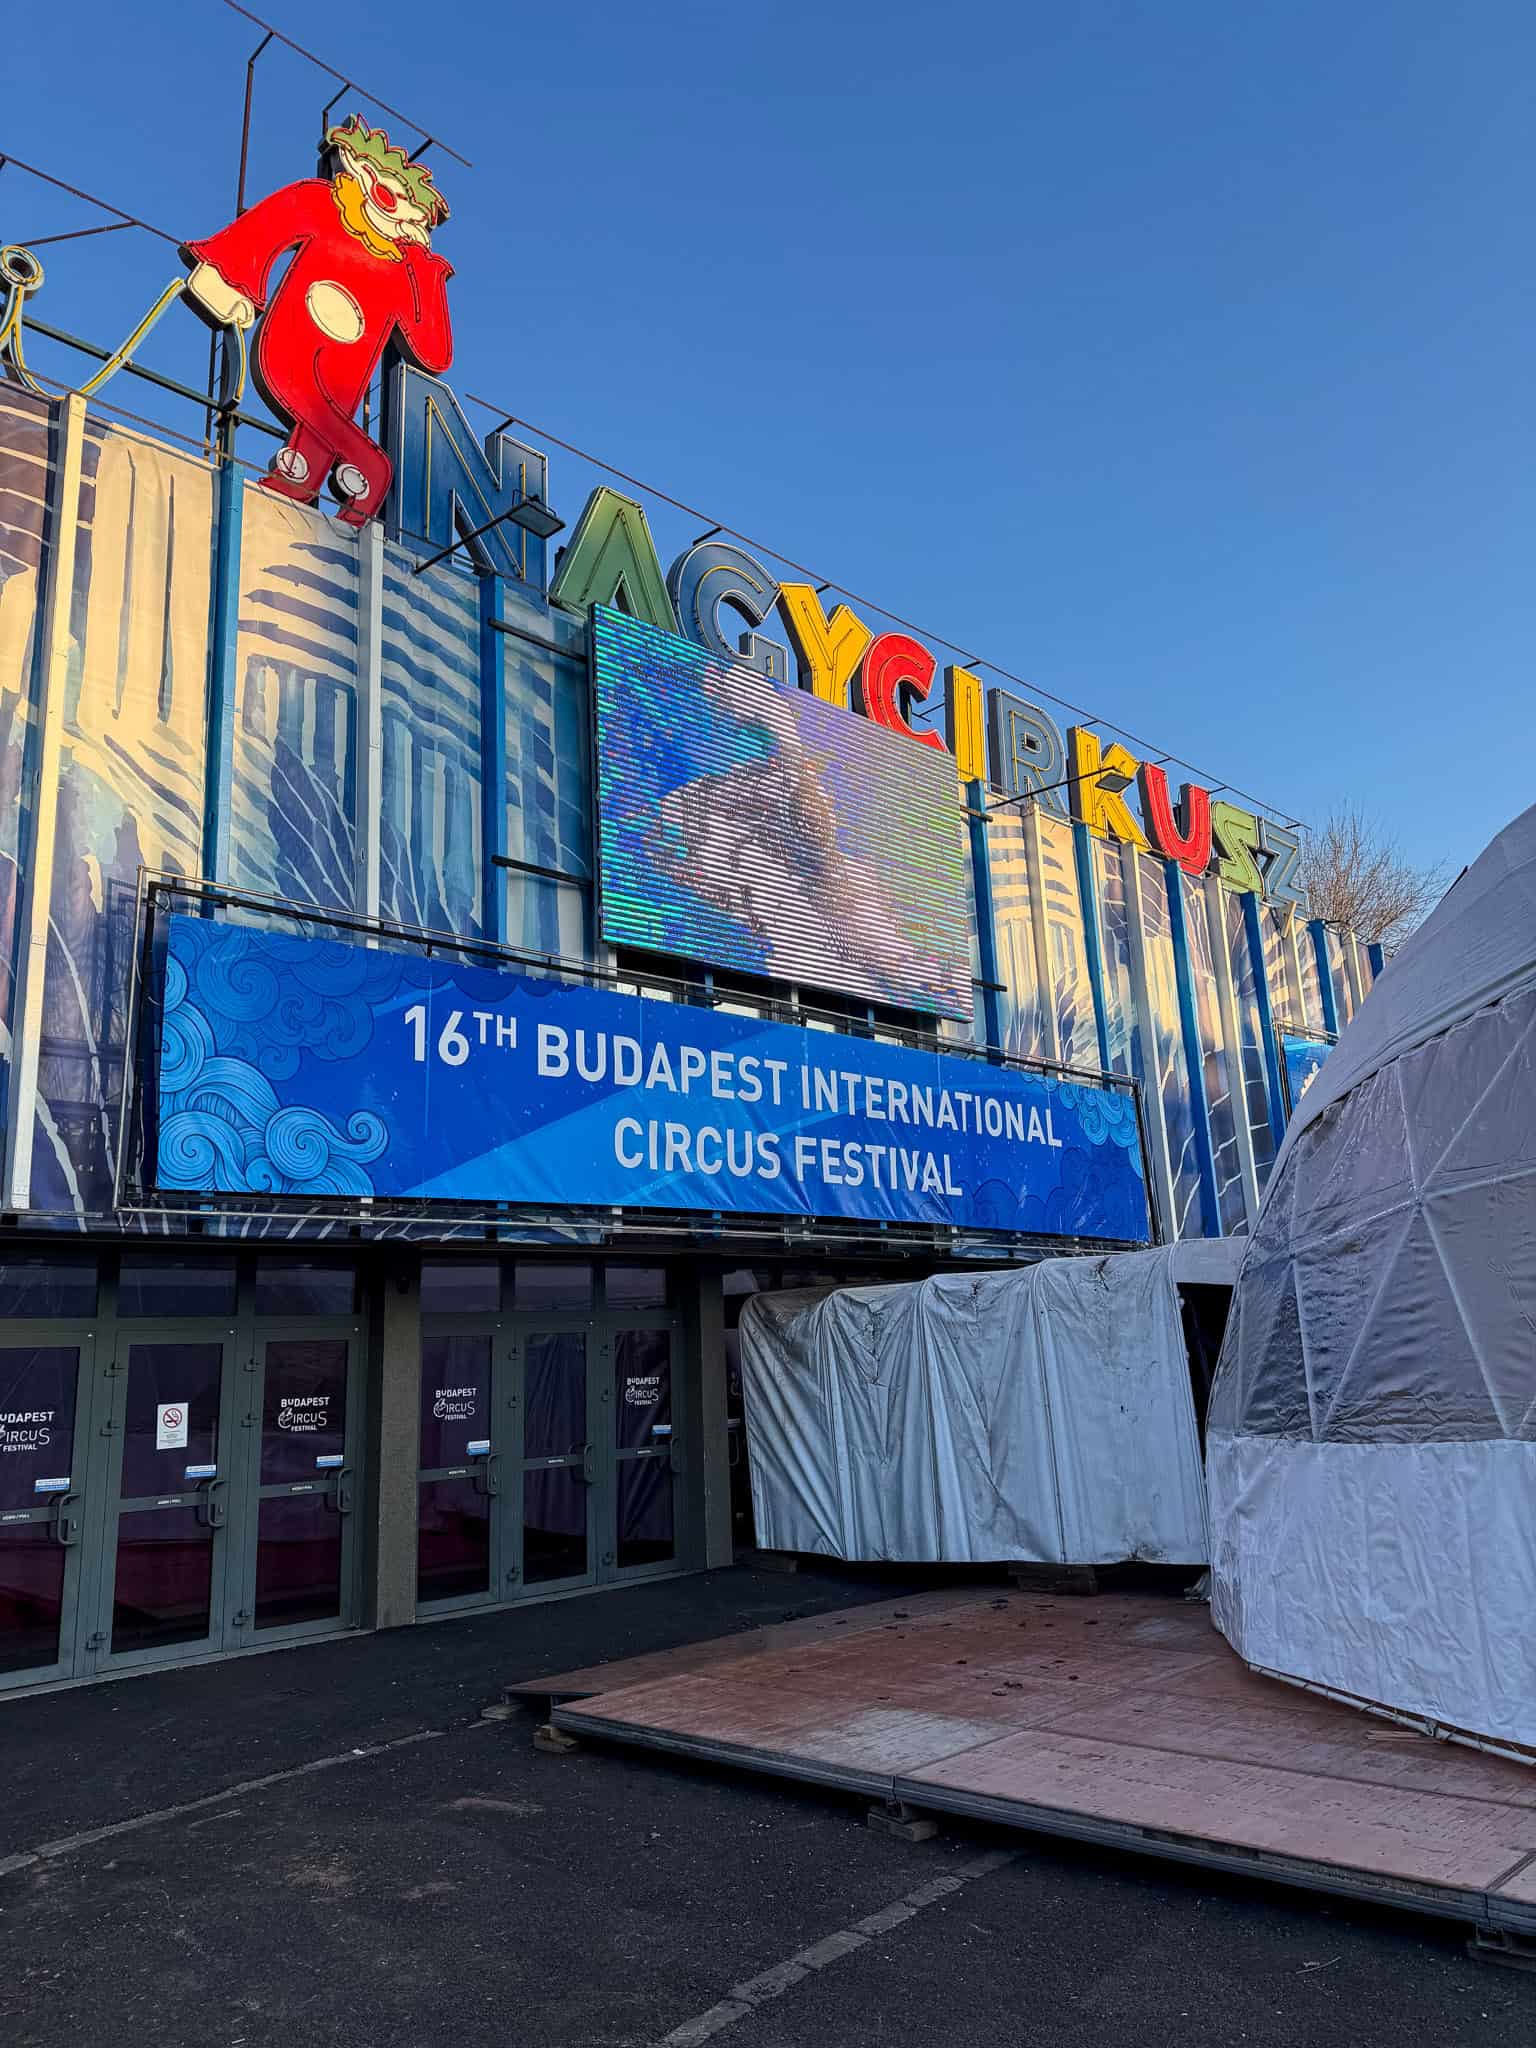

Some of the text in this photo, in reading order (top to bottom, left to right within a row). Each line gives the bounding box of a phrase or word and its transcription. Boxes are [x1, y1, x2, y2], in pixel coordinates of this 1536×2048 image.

[404, 1004, 1063, 1148] 16TH BUDAPEST INTERNATIONAL
[614, 1117, 963, 1196] CIRCUS FESTIVAL
[626, 1376, 660, 1386] BUDAPEST
[435, 1387, 477, 1399] BUDAPEST
[280, 1396, 331, 1408] BUDAPEST
[433, 1398, 475, 1418] CIRCUS
[0, 1410, 55, 1423] UDAPEST
[278, 1407, 327, 1429] CIRCUS
[2, 1443, 38, 1453] FESTIVAL
